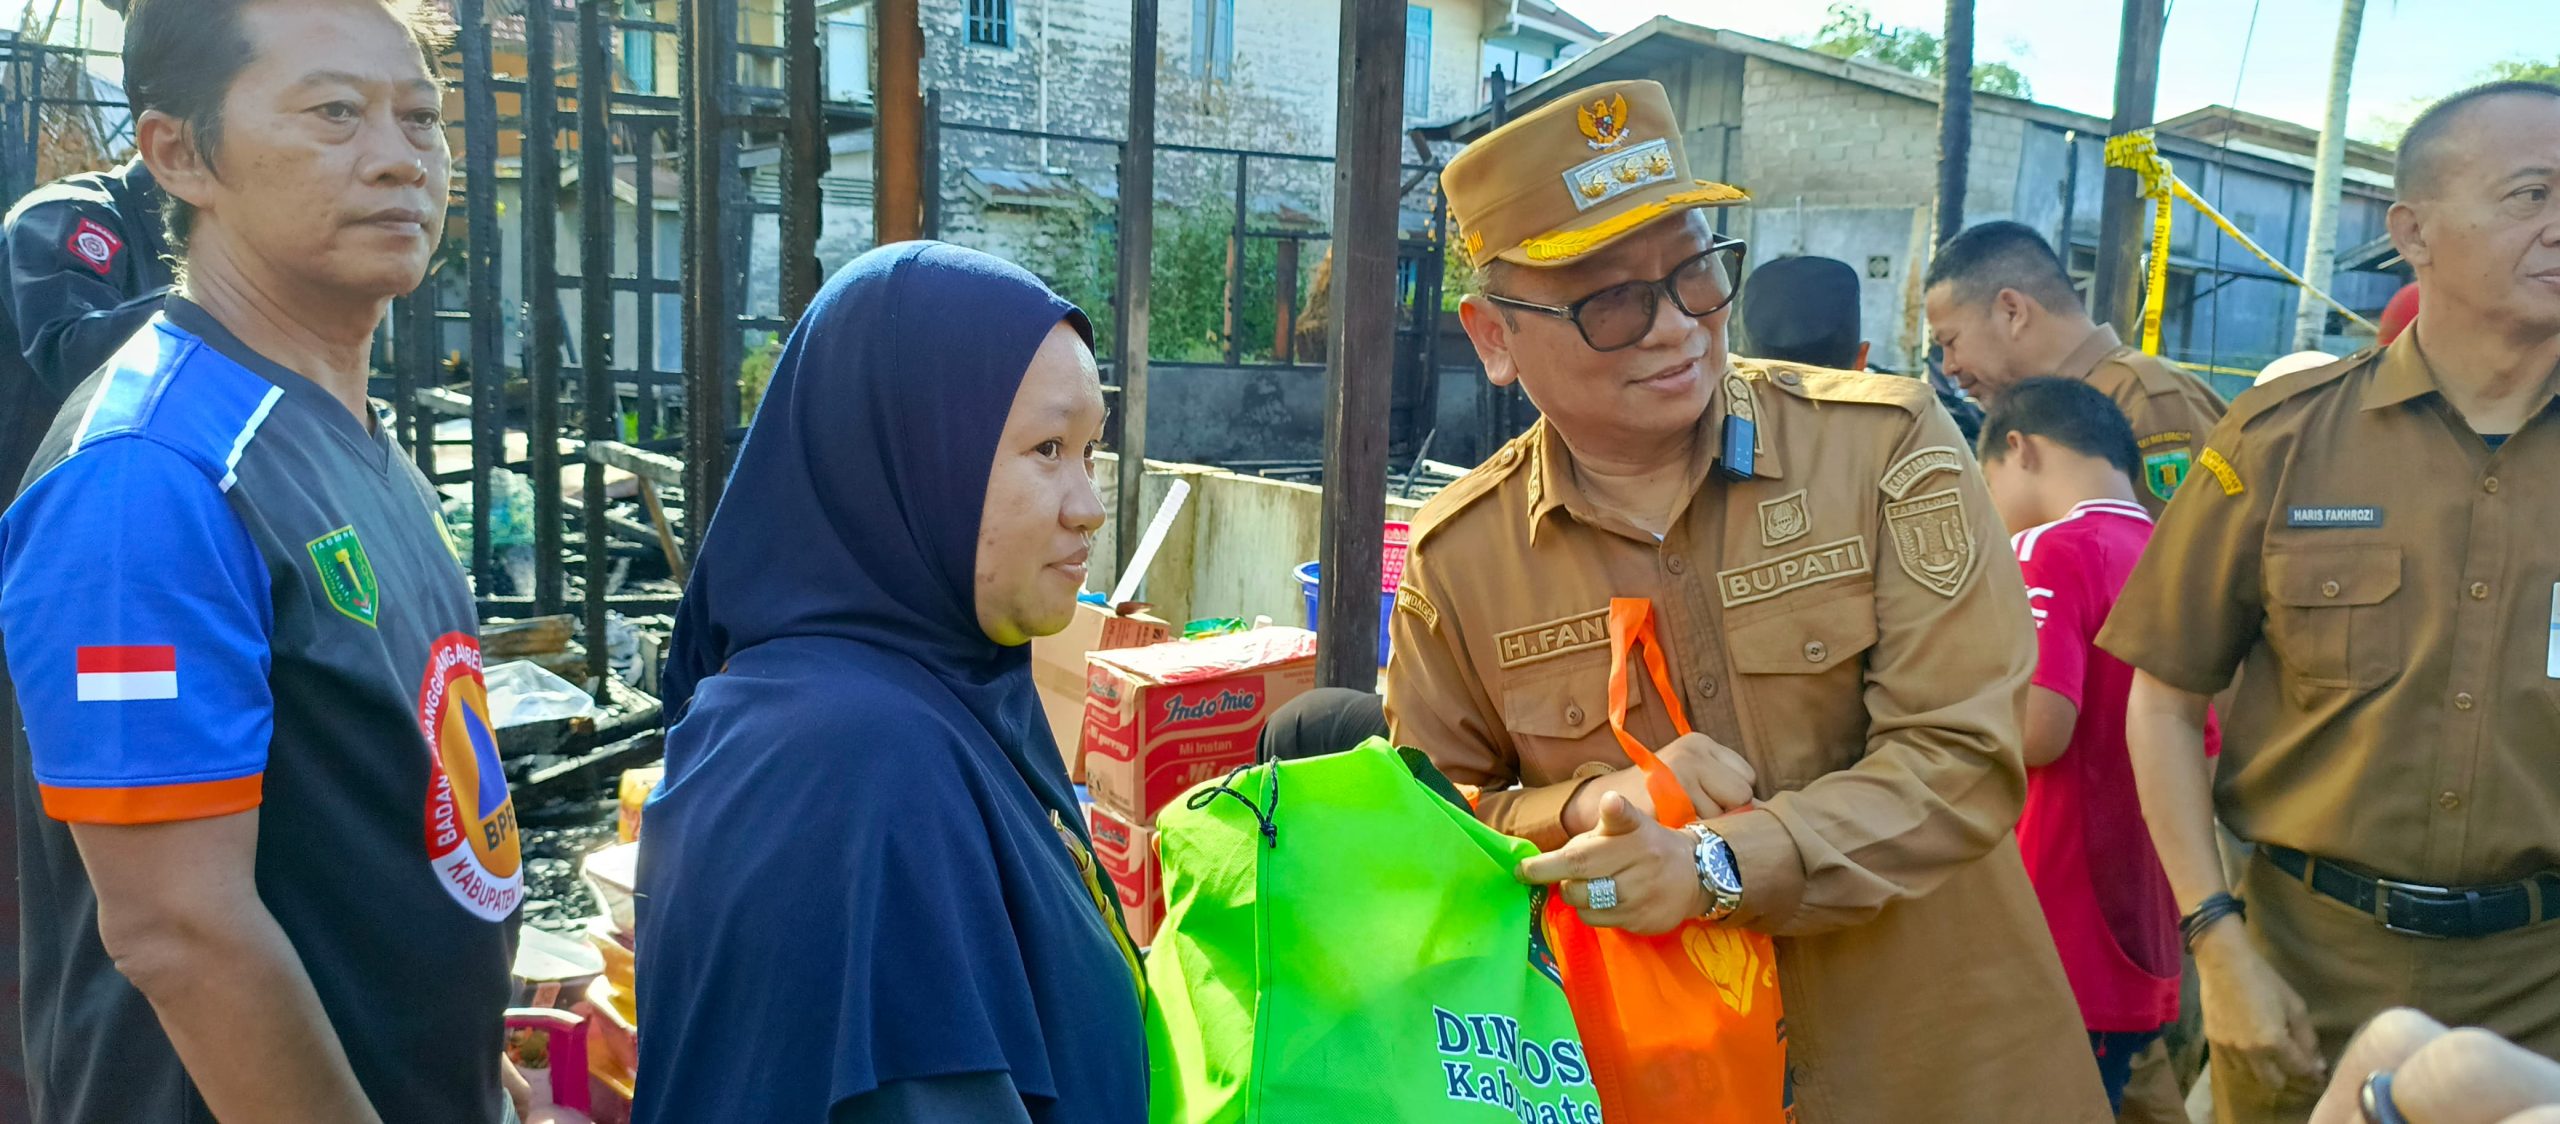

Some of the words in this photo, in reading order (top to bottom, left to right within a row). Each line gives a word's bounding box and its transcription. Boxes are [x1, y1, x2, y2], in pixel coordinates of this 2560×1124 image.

[2294, 508, 2323, 521] HARIS
[2325, 508, 2374, 521] FAKHROZI
[1729, 545, 1858, 597] BUPATI
[435, 775, 458, 847] BADAN
